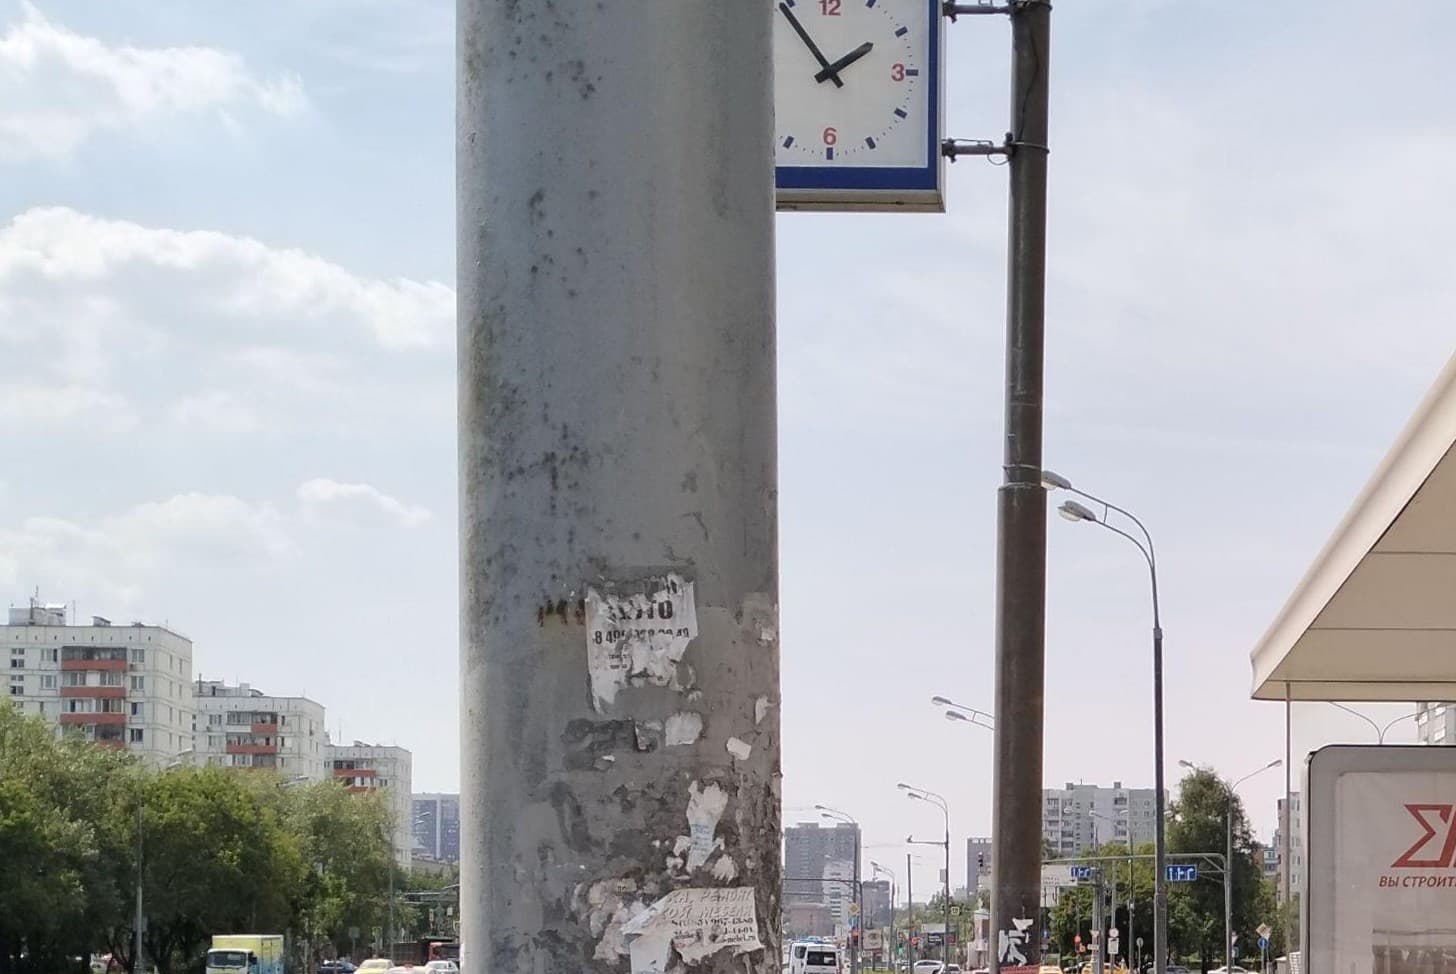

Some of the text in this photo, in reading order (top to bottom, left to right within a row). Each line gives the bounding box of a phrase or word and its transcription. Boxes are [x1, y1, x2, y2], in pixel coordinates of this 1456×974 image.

[818, 0, 841, 16] 12
[891, 63, 905, 82] 3
[823, 127, 837, 145] 6
[1379, 876, 1399, 888] ВЫ
